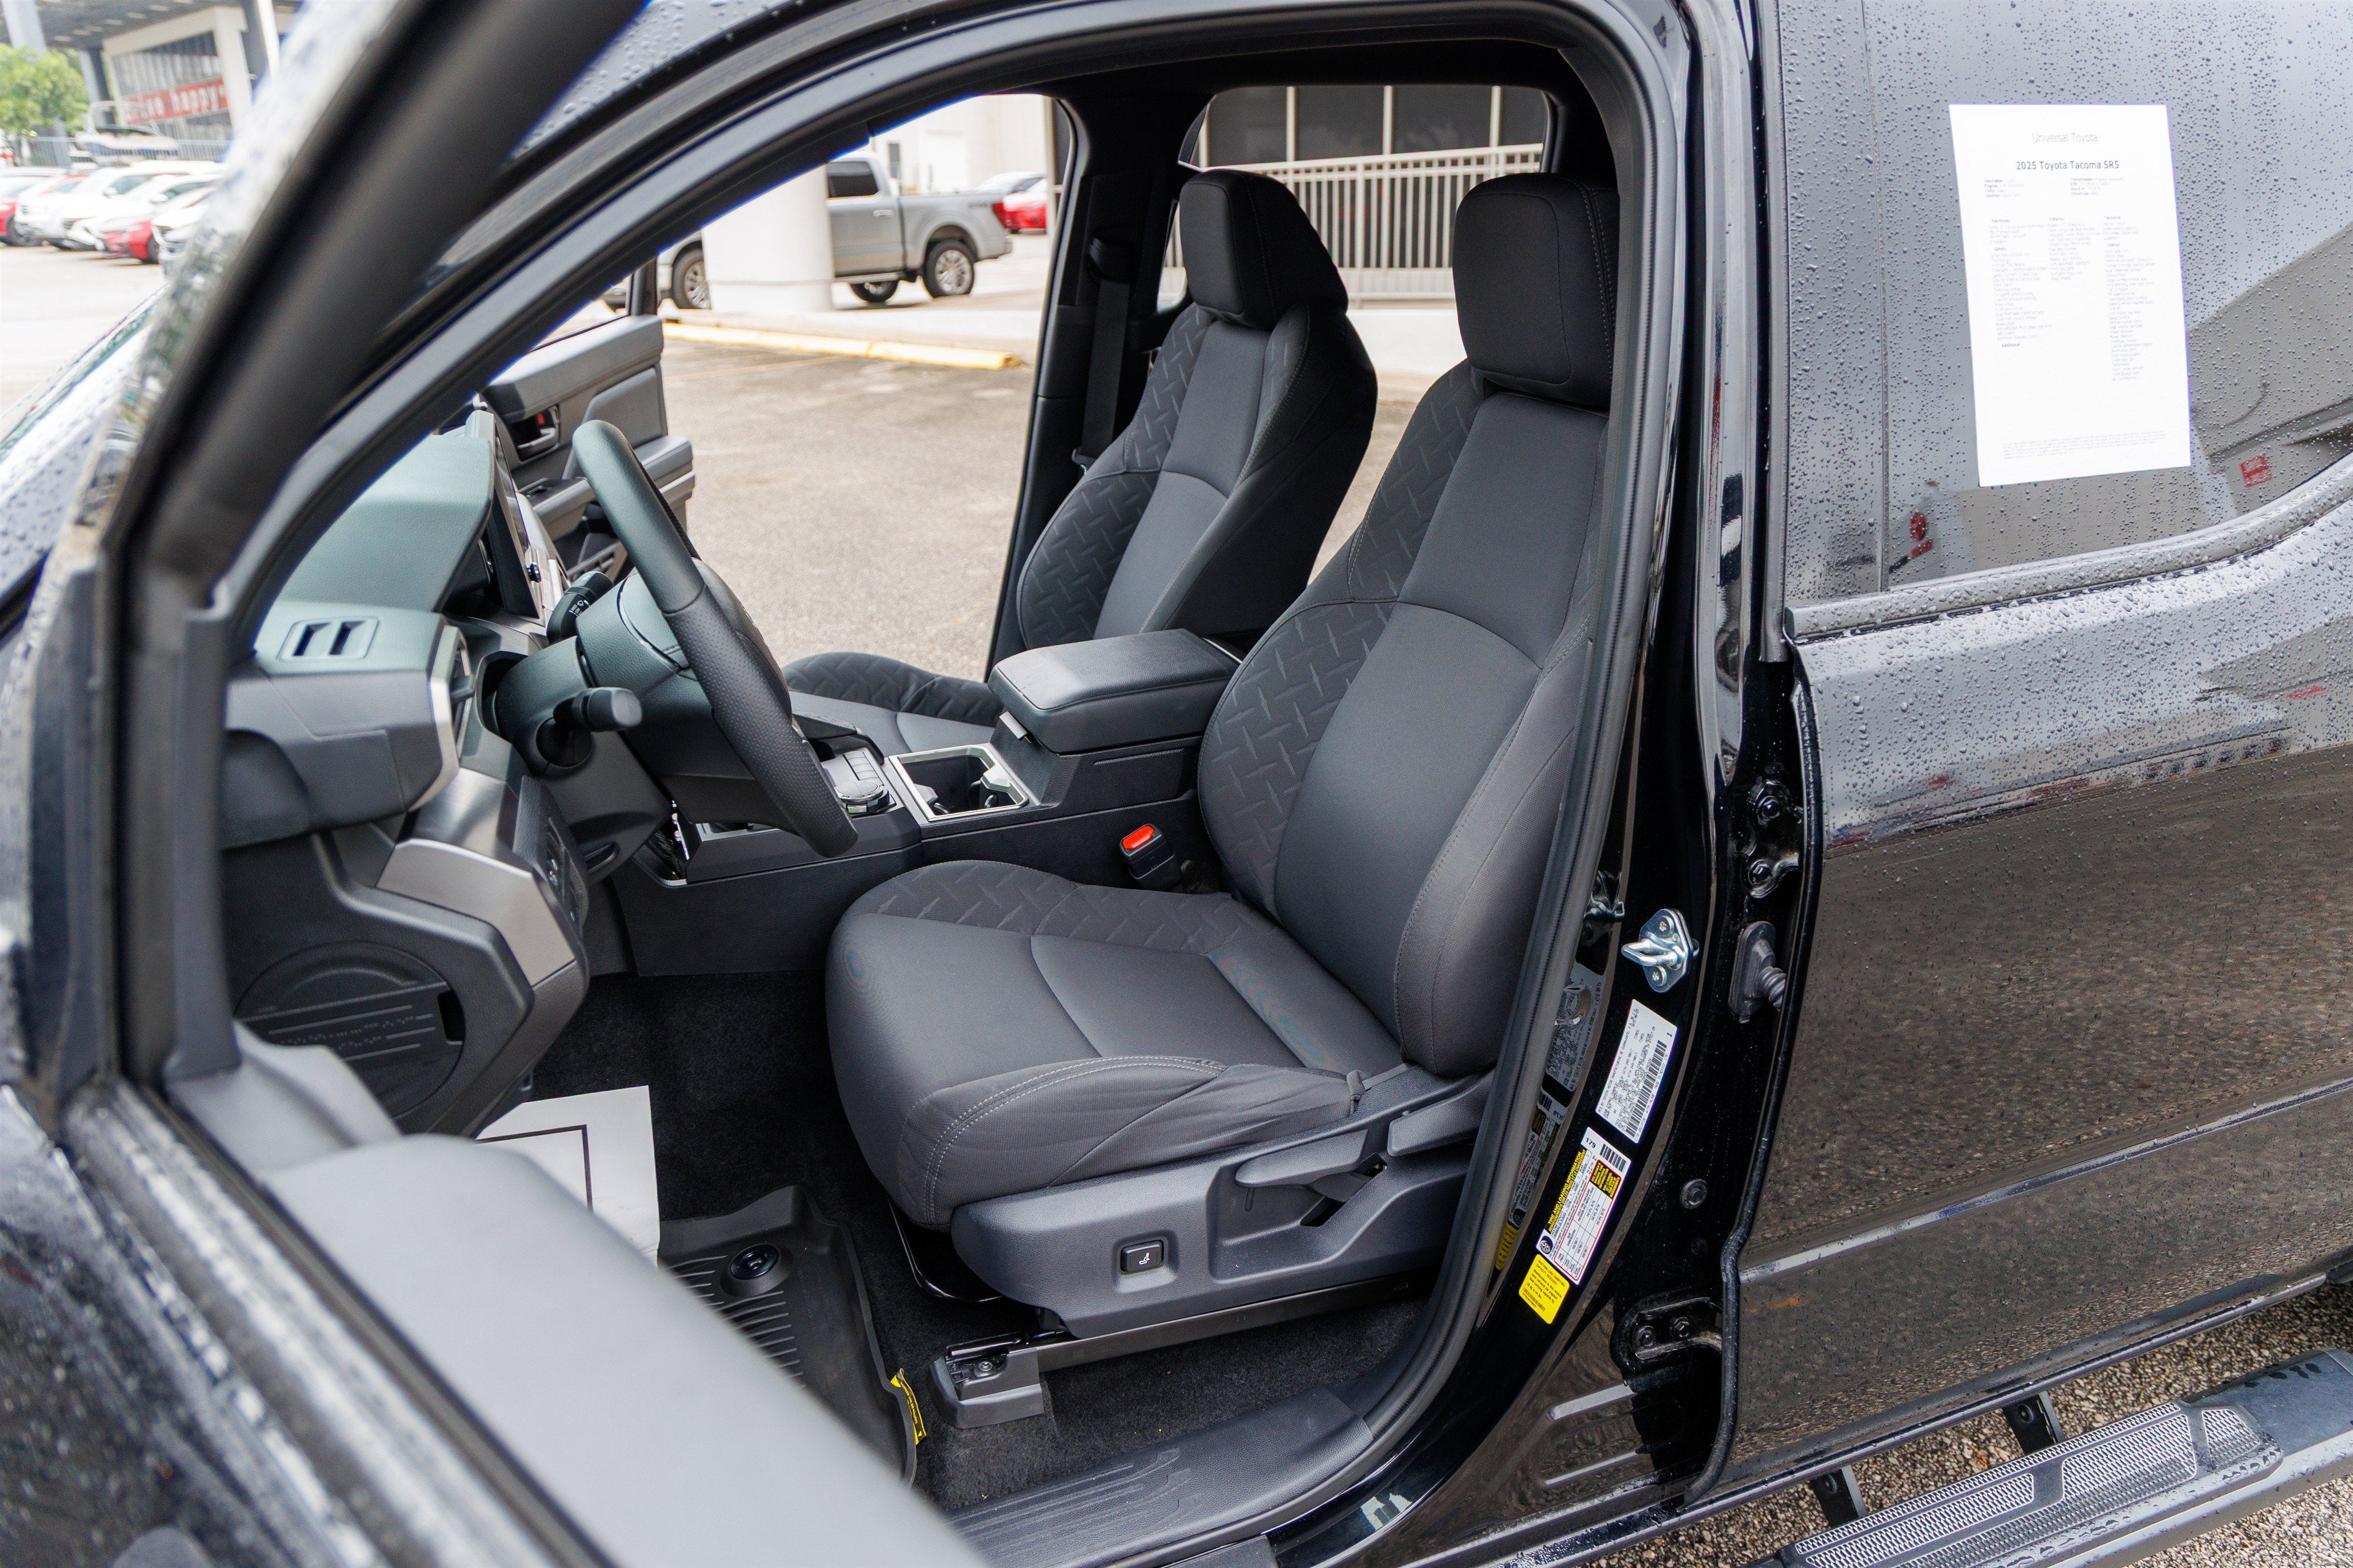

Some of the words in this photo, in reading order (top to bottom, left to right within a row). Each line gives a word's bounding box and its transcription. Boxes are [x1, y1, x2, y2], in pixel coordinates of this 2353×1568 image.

[2032, 133, 2068, 142] Universal
[2071, 133, 2098, 143] Toyota
[2016, 161, 2037, 170] 2025
[2039, 161, 2067, 171] Toyota
[2069, 161, 2101, 169] Tacoma
[2104, 160, 2119, 169] SR5
[1585, 1137, 1596, 1148] 179
[1557, 1183, 1568, 1204] LOADING
[1565, 1150, 1582, 1184] INFORMATION
[1536, 1263, 1546, 1275] CAPACITY
[1546, 1273, 1557, 1285] REDUCED
[1538, 1259, 1548, 1270] CAUTION
[1553, 1273, 1565, 1288] CARRYING
